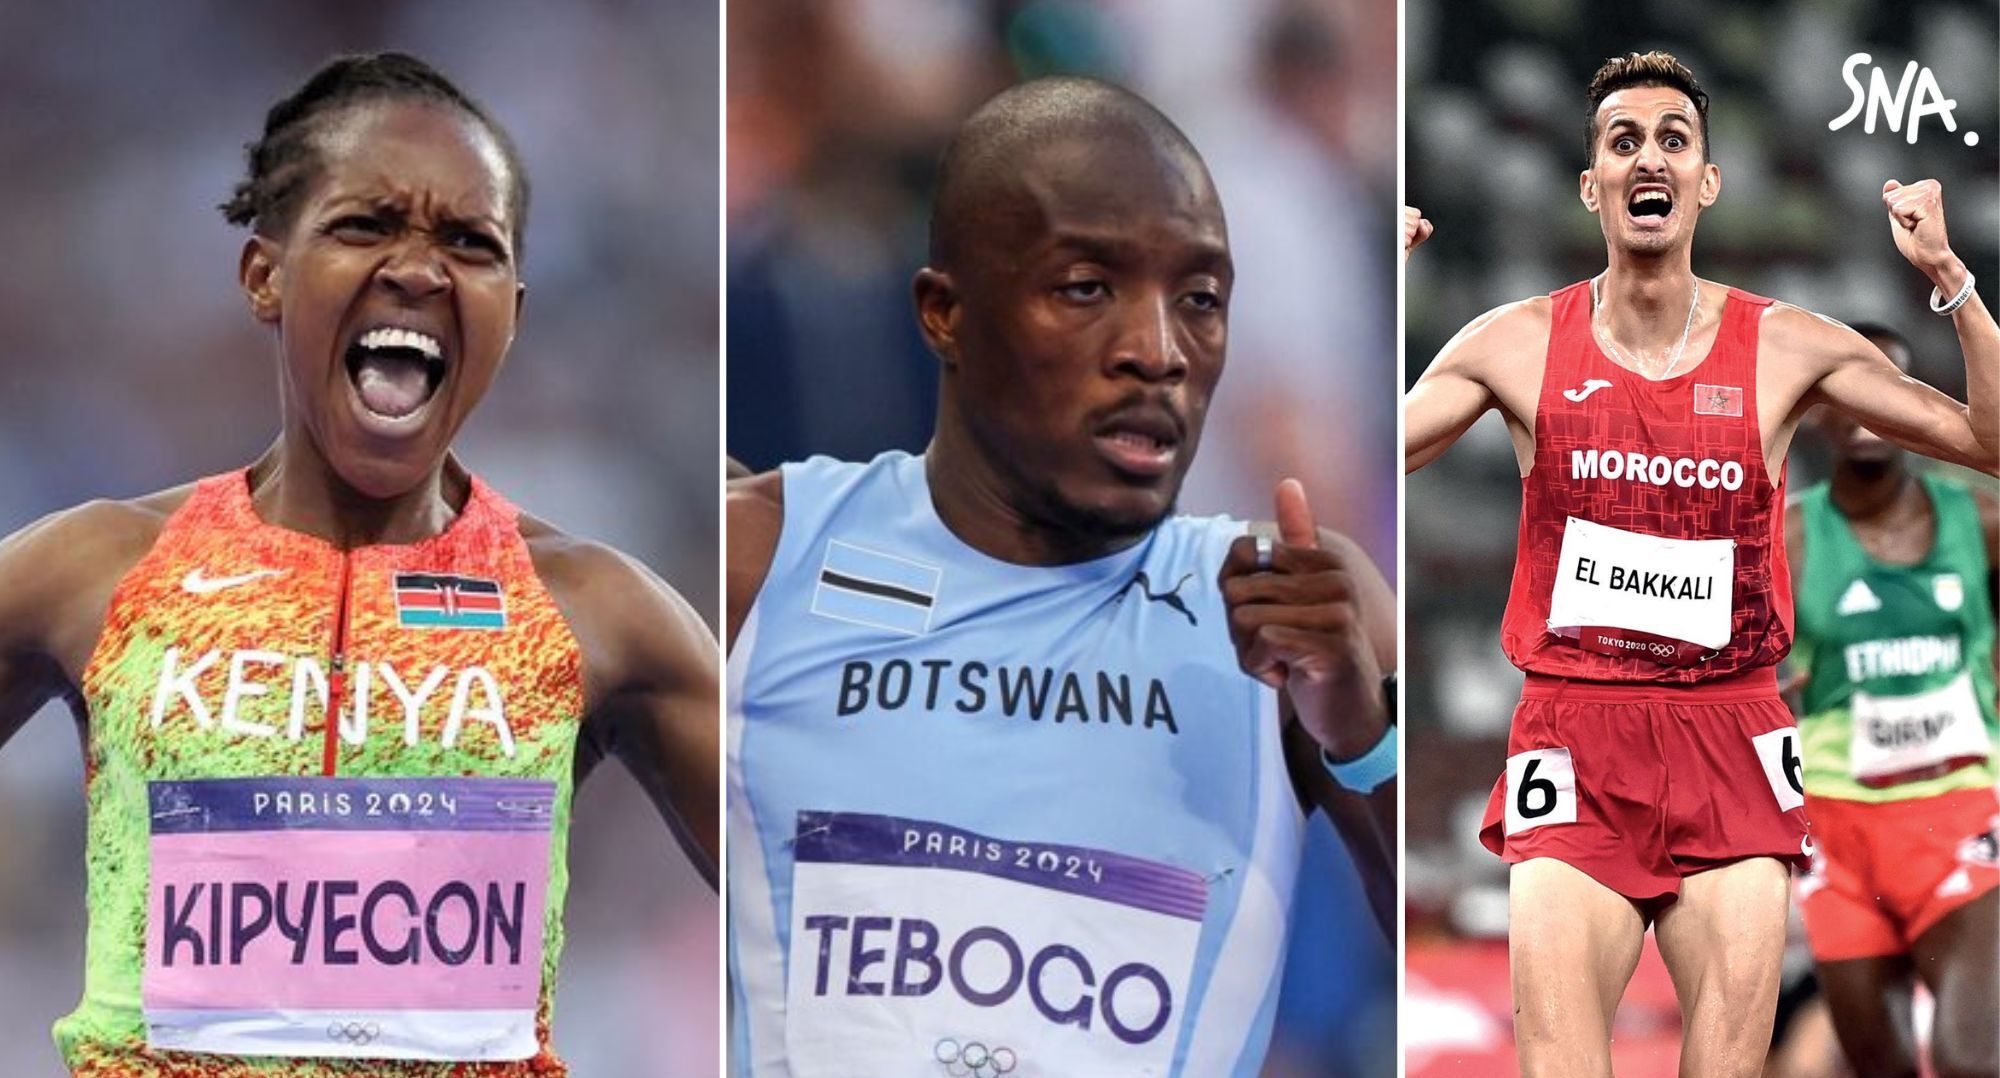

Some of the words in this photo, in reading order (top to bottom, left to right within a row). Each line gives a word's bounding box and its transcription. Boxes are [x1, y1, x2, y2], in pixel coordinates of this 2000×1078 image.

[1571, 449, 1744, 491] MOROCCO
[1575, 556, 1600, 586] EL
[1609, 565, 1713, 600] BAKKALI
[1597, 635, 1625, 648] TOKYO
[1625, 641, 1647, 651] 2020
[150, 647, 517, 759] KENYA
[836, 658, 1179, 734] BOTSWANA
[253, 793, 352, 816] PARIS
[366, 793, 458, 816] 2024
[1517, 758, 1557, 819] 6
[903, 829, 1001, 861] PARIS
[1014, 847, 1102, 884] 2024
[161, 879, 526, 966] KIPYEGON
[804, 913, 1173, 1045] TEBOGO
